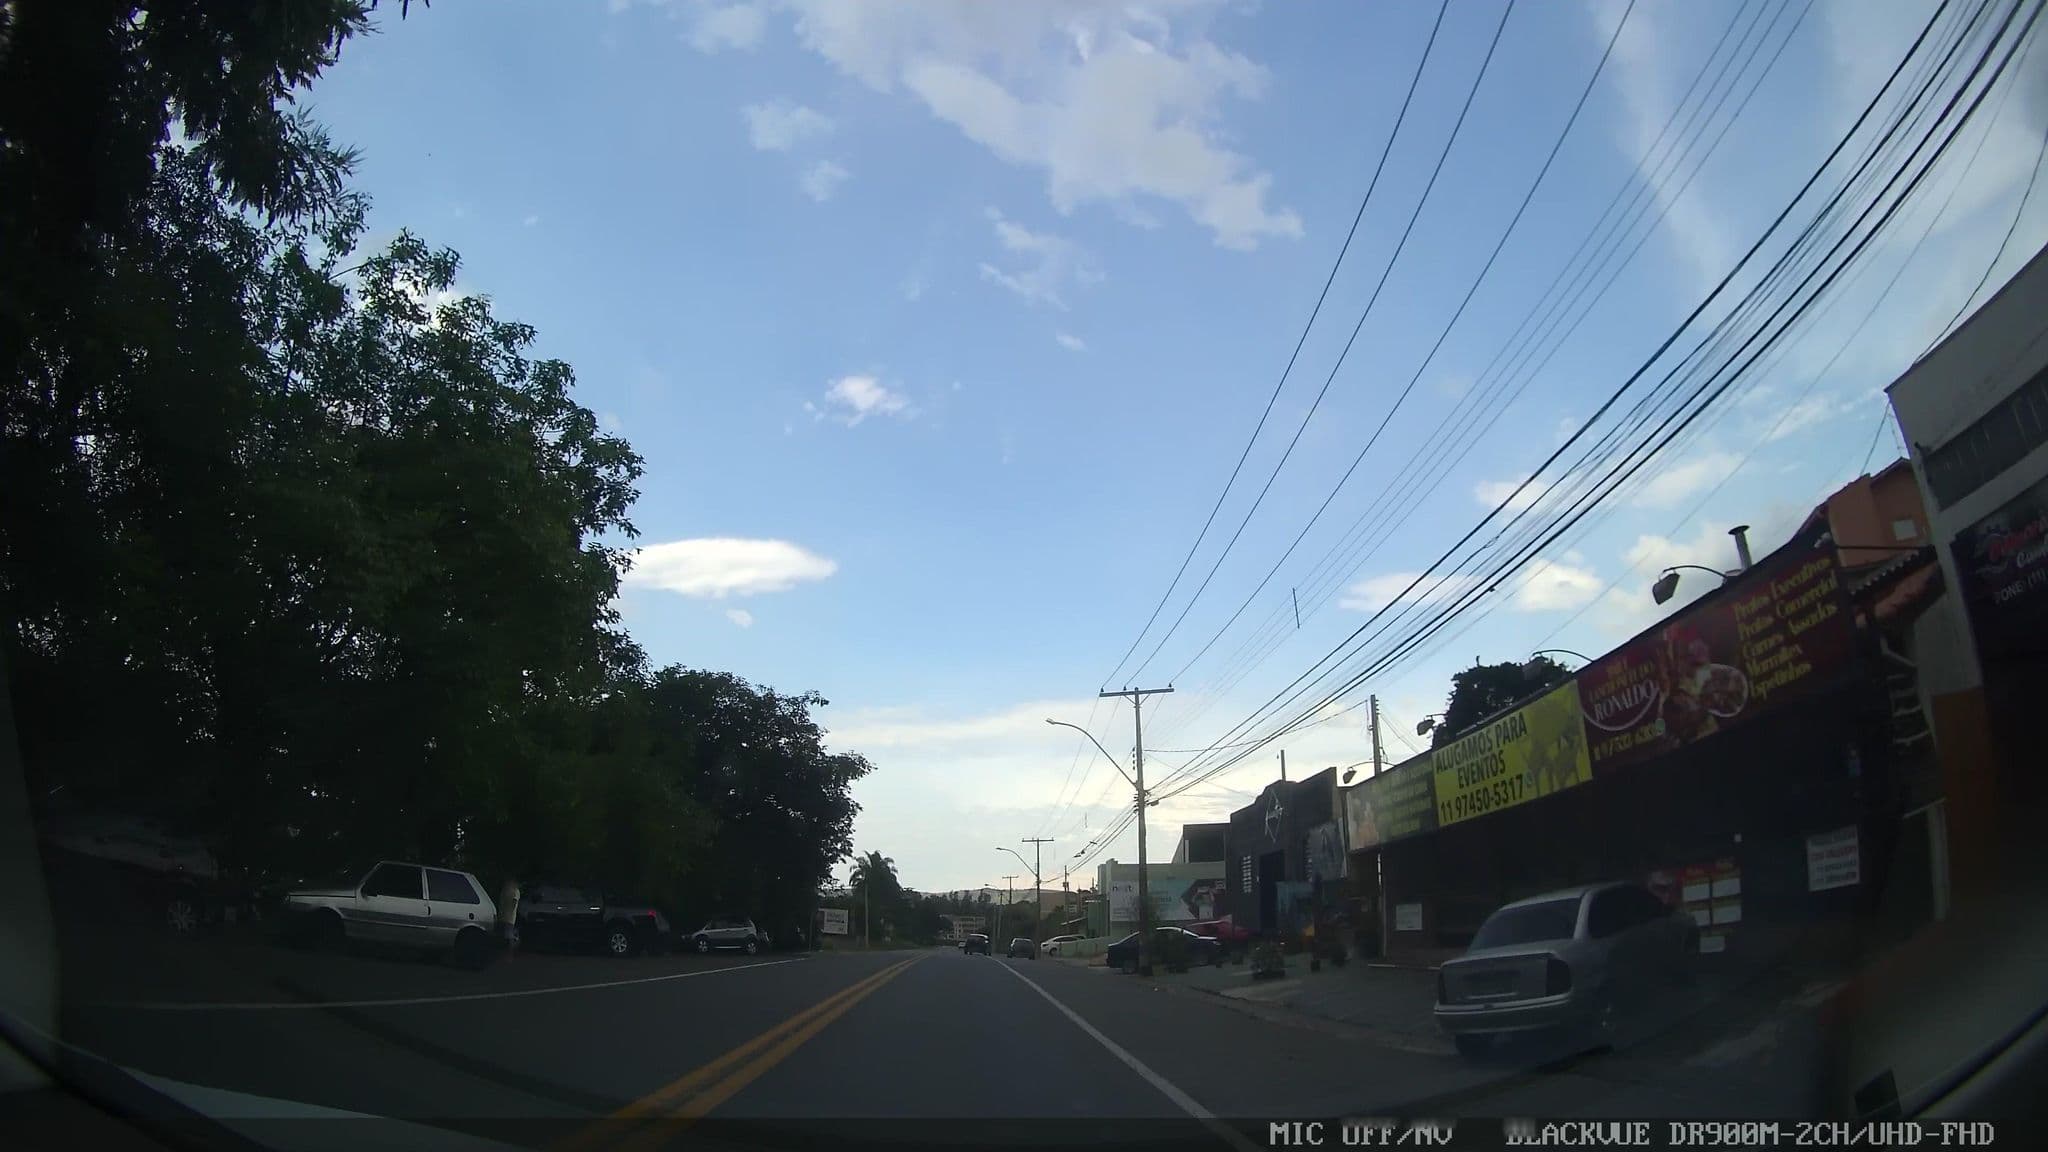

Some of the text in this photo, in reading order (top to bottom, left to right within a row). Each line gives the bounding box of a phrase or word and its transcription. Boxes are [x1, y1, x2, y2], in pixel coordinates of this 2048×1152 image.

[1593, 679, 1656, 722] RONALDO
[1436, 711, 1528, 774] ALUGAMOS PARA
[1457, 750, 1506, 789] EVENTOS
[1440, 773, 1524, 822] 11 97450-5317
